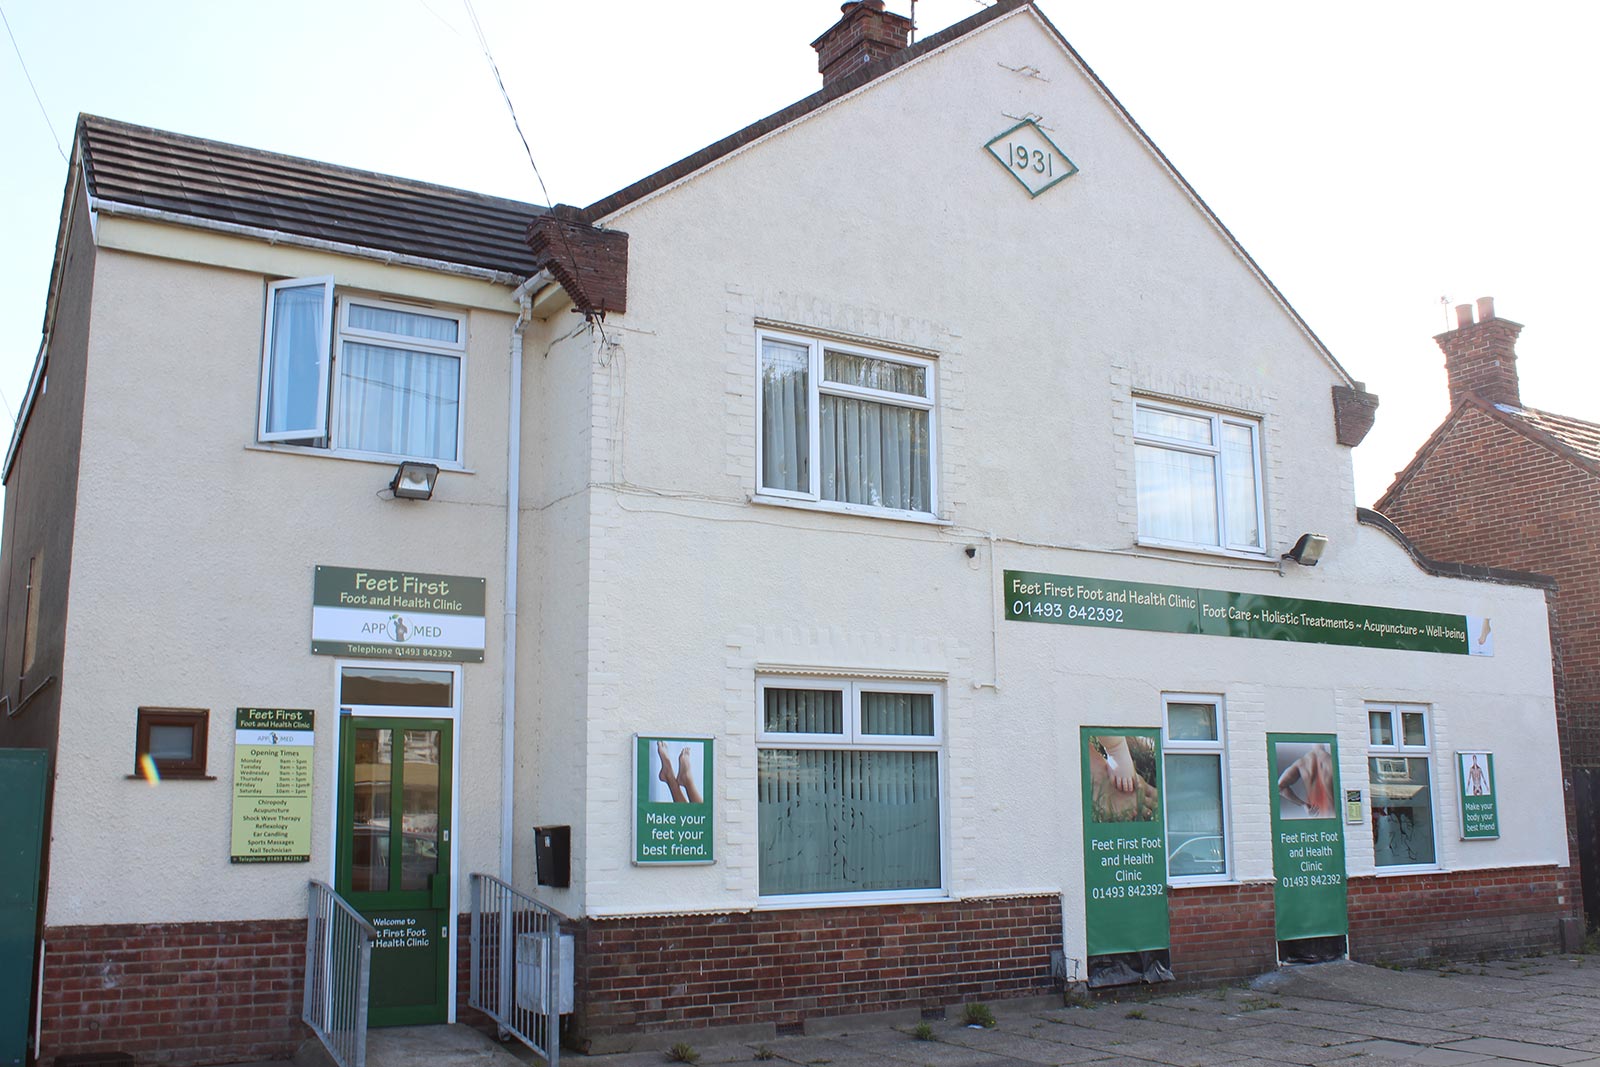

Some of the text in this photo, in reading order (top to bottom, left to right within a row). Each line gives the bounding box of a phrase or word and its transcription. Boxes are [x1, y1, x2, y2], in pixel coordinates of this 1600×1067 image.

[1009, 142, 1052, 177] 1931
[355, 572, 450, 596] Feet First
[1013, 579, 1196, 609] Feet First Foot and Health Clinic
[340, 592, 462, 611] Foot and Health Clinic
[1013, 600, 1124, 622] 01493 842392
[1202, 604, 1227, 618] Foot
[1228, 606, 1252, 620] Care
[1261, 610, 1299, 624] Holistic
[1300, 614, 1354, 630] Treatments
[1364, 620, 1418, 636] Acupuncture
[1426, 625, 1465, 642] Well-being
[362, 622, 442, 638] APP MED
[348, 644, 452, 658] Telephone 01493 842392
[249, 709, 302, 720] Feet First
[646, 812, 706, 826] Make your
[1466, 814, 1480, 822] body
[652, 828, 704, 842] feet your
[1280, 832, 1338, 843] Feet First Foot
[642, 844, 707, 855] best friend.
[1092, 837, 1162, 850] Feet First Foot
[1289, 846, 1332, 858] and Health
[1101, 853, 1154, 866] and Health
[1300, 861, 1322, 872] Clinic
[1115, 870, 1142, 882] Clinic
[1282, 874, 1341, 887] 01493 842392
[1092, 884, 1163, 899] 01493 842392
[373, 918, 406, 926] Welcome
[383, 929, 405, 938] First
[406, 928, 427, 937] Foot
[376, 939, 405, 948] Health
[406, 938, 430, 947] Clinic
